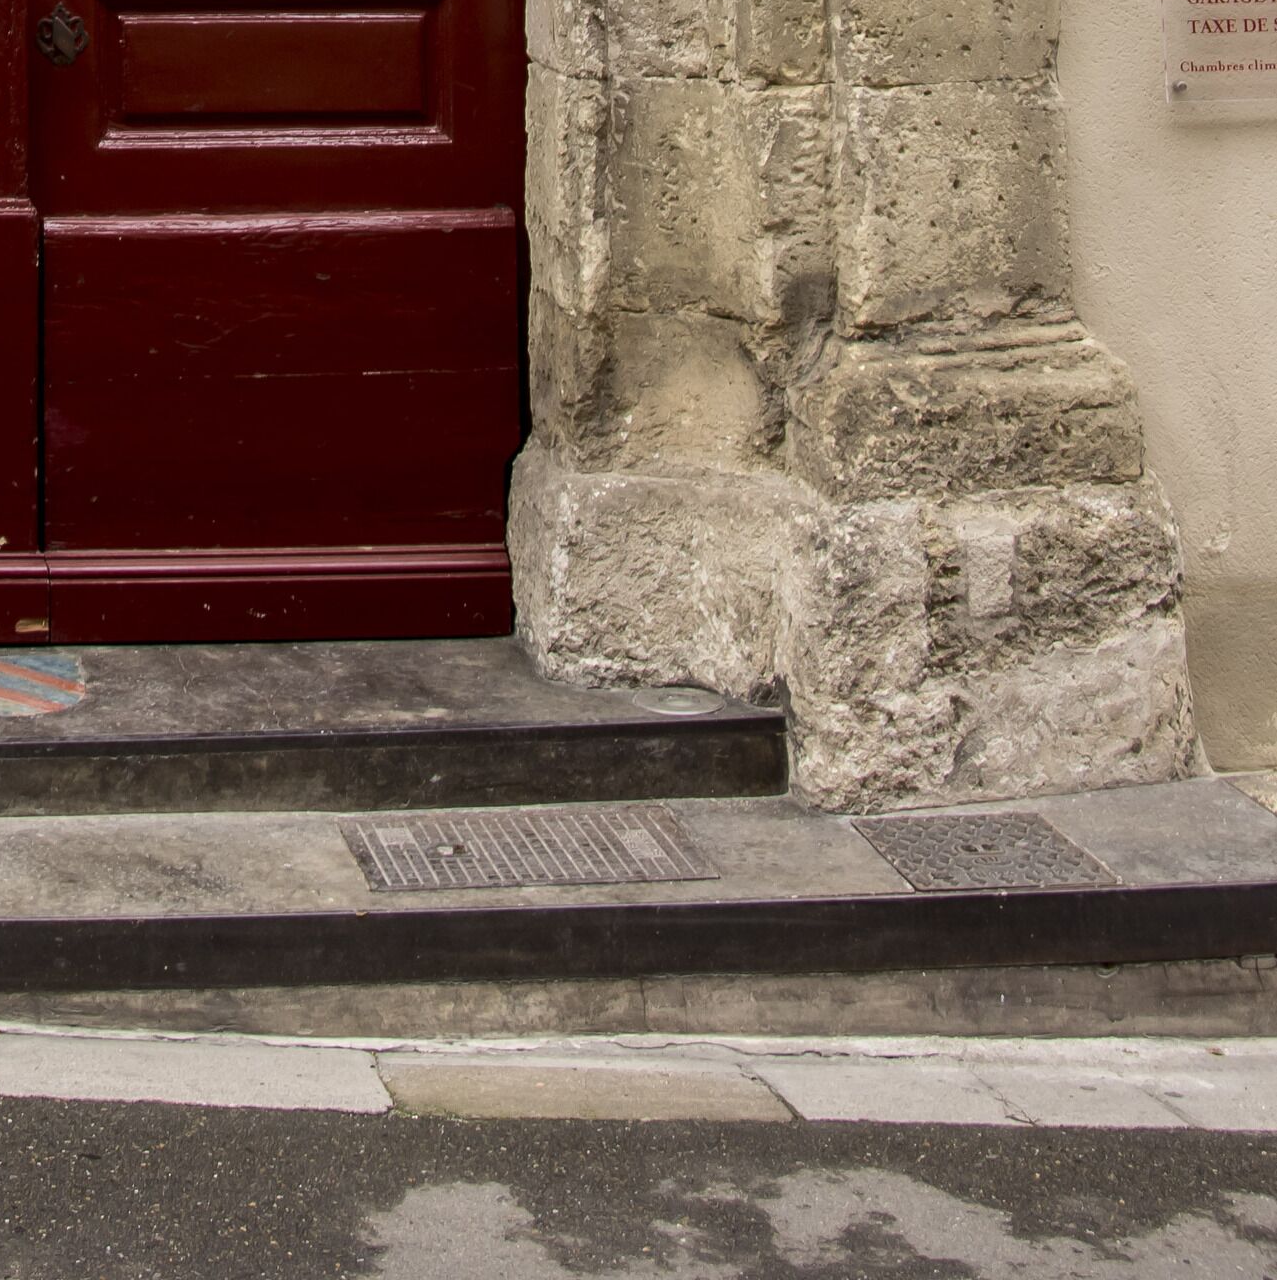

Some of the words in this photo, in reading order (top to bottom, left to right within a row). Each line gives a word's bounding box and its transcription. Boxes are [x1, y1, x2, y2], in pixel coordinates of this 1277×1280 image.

[1187, 18, 1237, 34] TAXE
[1244, 17, 1269, 33] DE
[1180, 60, 1244, 73] Chambres
